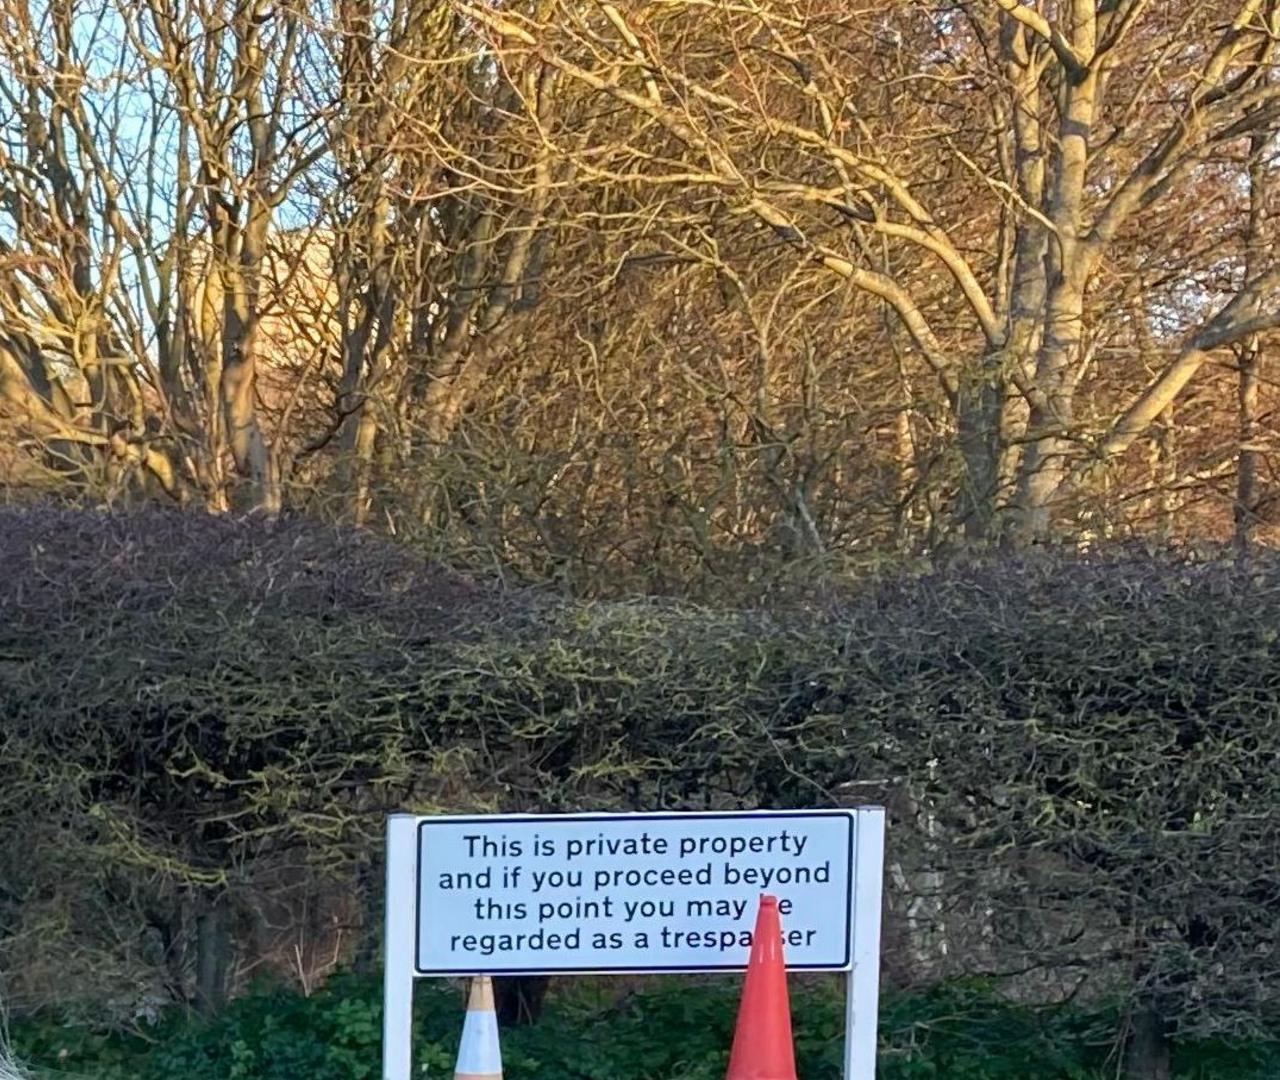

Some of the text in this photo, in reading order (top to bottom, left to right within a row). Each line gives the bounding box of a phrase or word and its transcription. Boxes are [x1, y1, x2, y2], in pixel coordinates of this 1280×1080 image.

[464, 830, 808, 861] This is private property
[439, 861, 830, 893] and if you proceed beyond
[475, 898, 526, 920] this
[539, 896, 612, 923] point
[625, 901, 674, 922] you
[687, 900, 747, 921] may
[452, 926, 817, 956] regarded as a trespaer
